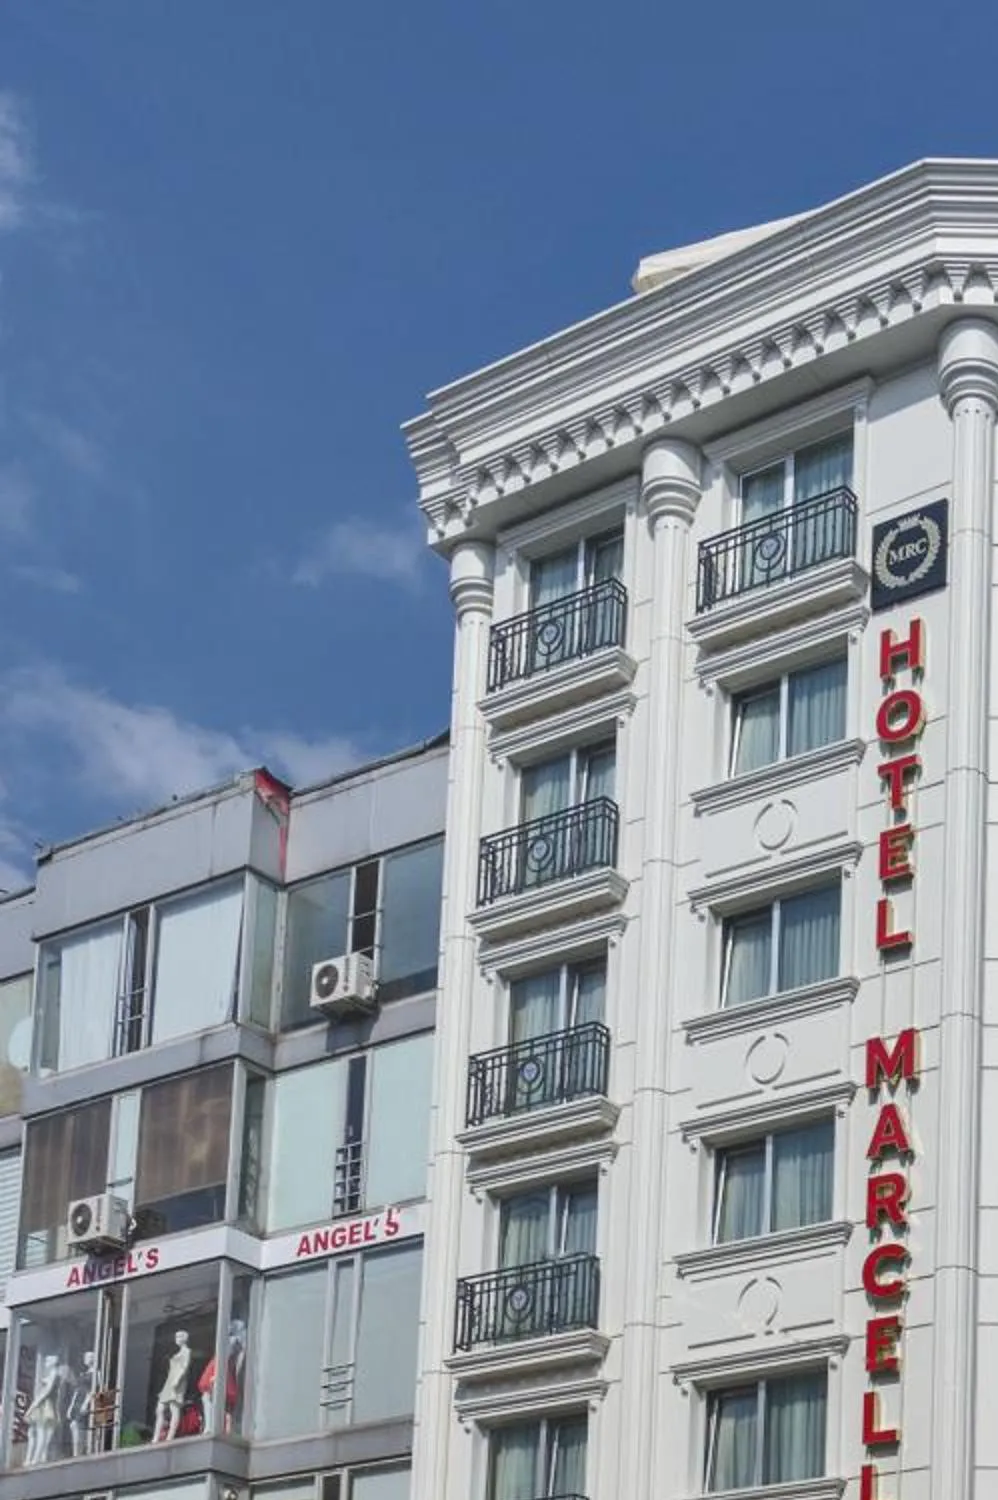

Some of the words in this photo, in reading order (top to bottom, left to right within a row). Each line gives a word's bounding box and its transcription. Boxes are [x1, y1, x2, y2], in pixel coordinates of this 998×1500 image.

[889, 538, 928, 565] MRC
[876, 617, 923, 951] HOTEL
[297, 1207, 399, 1256] ANGEL'S
[67, 1247, 159, 1288] ANGEL'S
